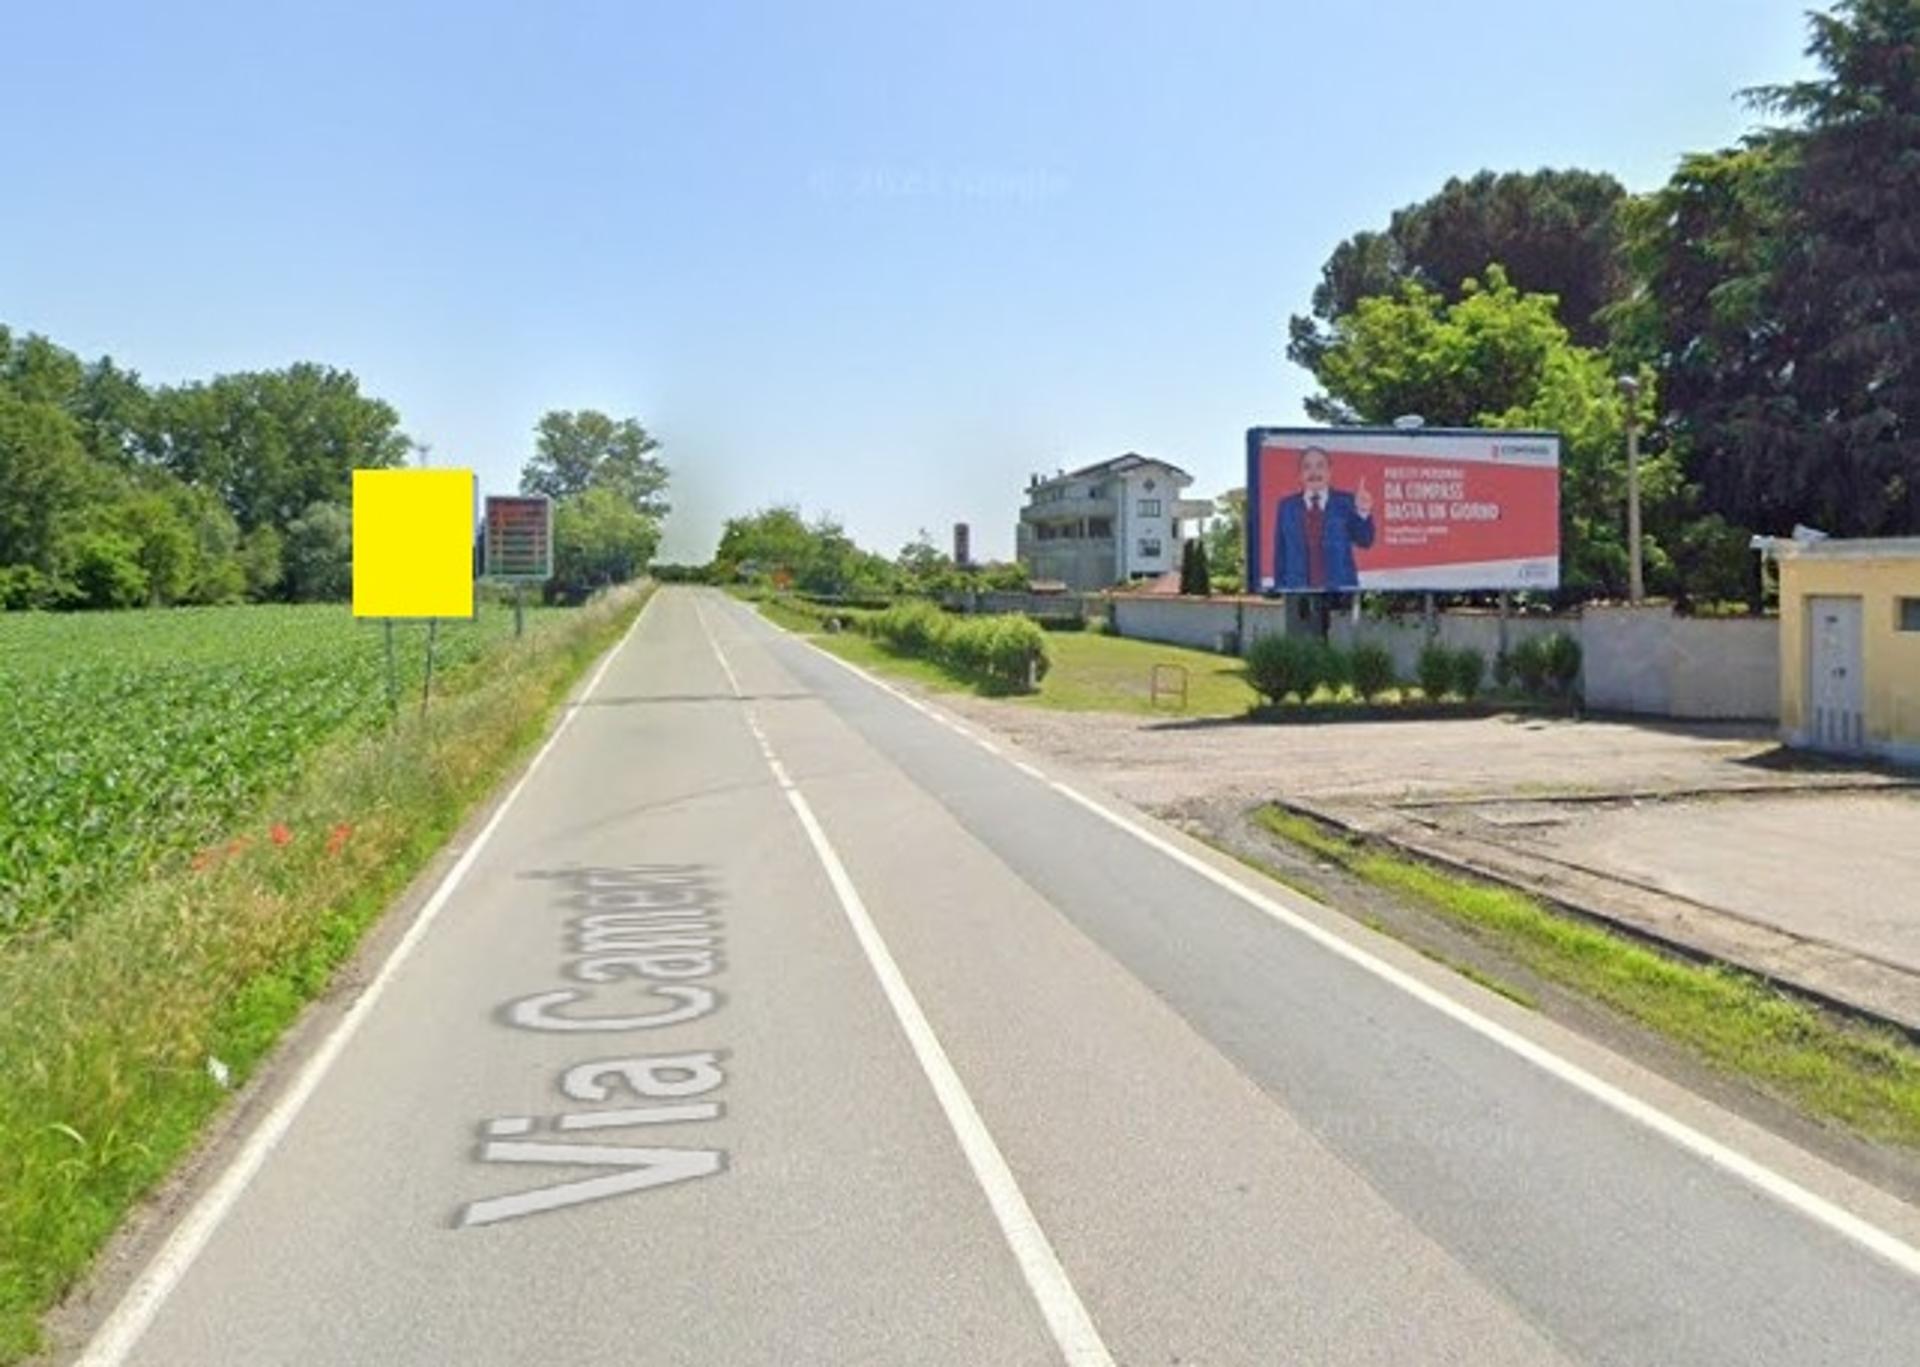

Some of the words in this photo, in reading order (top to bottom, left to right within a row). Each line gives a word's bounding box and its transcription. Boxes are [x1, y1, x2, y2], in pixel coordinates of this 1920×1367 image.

[1384, 481, 1403, 499] DA
[1405, 481, 1464, 499] COMPASS
[1384, 502, 1425, 519] BASTA
[1427, 502, 1446, 519] UN
[1450, 502, 1499, 520] GIORNO
